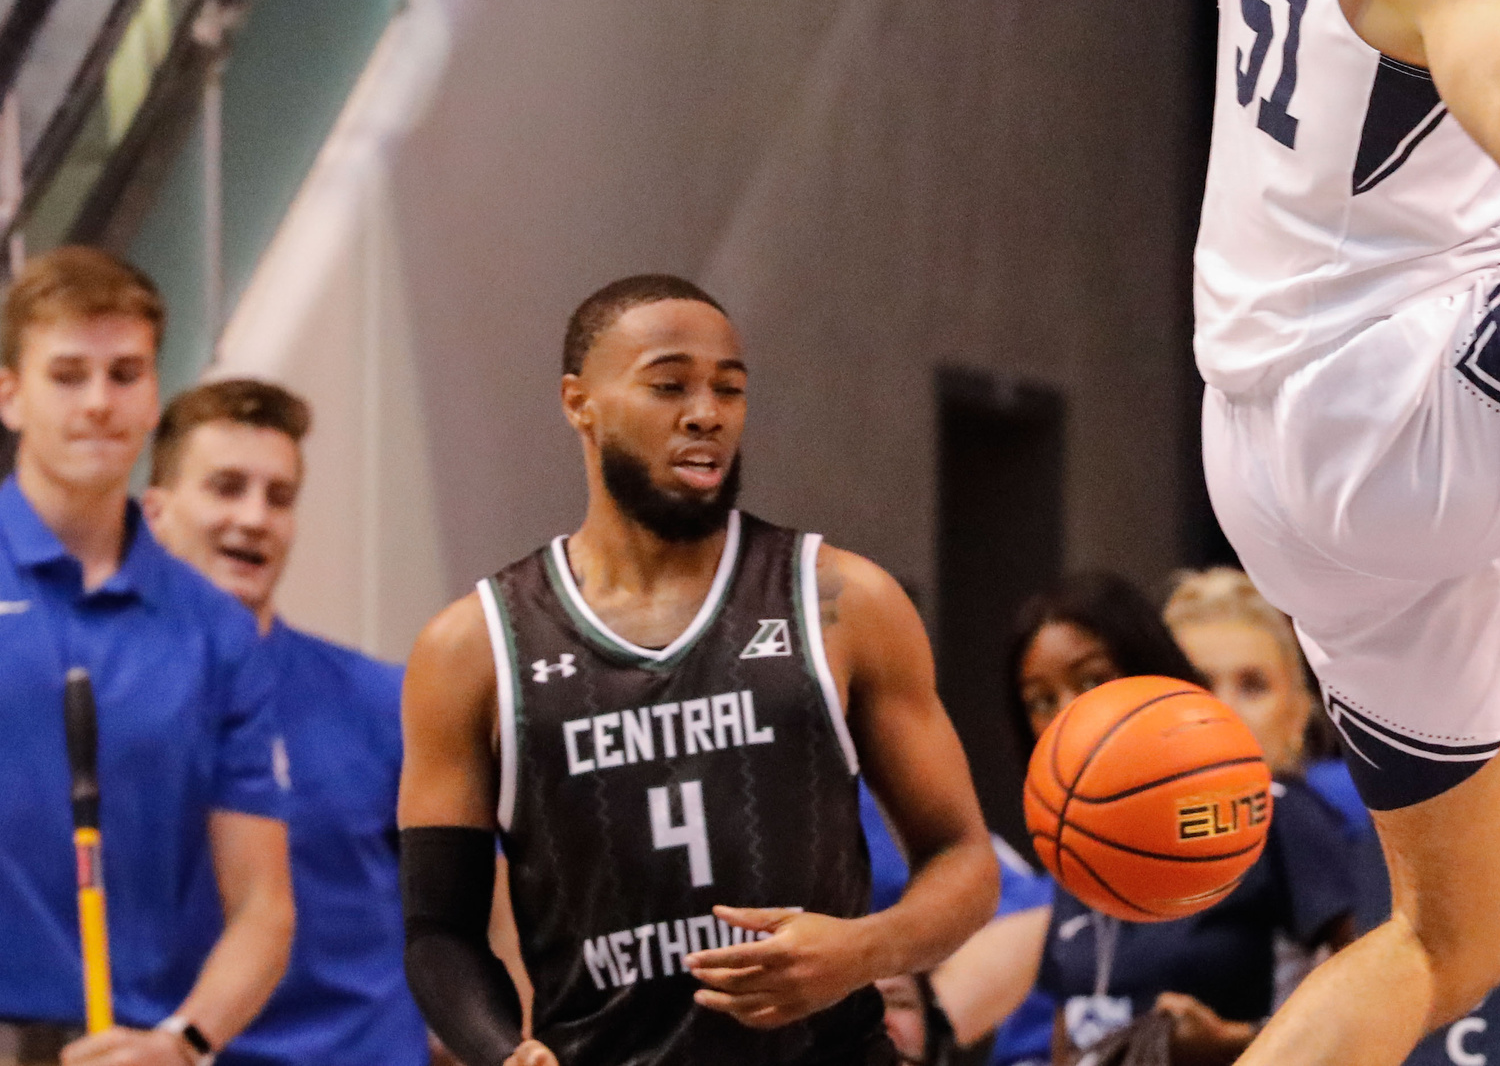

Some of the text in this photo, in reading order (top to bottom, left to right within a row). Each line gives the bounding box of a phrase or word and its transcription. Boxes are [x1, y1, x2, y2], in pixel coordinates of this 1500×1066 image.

[562, 690, 774, 775] CENTRAL
[646, 780, 714, 888] 4
[1179, 790, 1267, 840] ELITE
[583, 906, 804, 991] METHO
